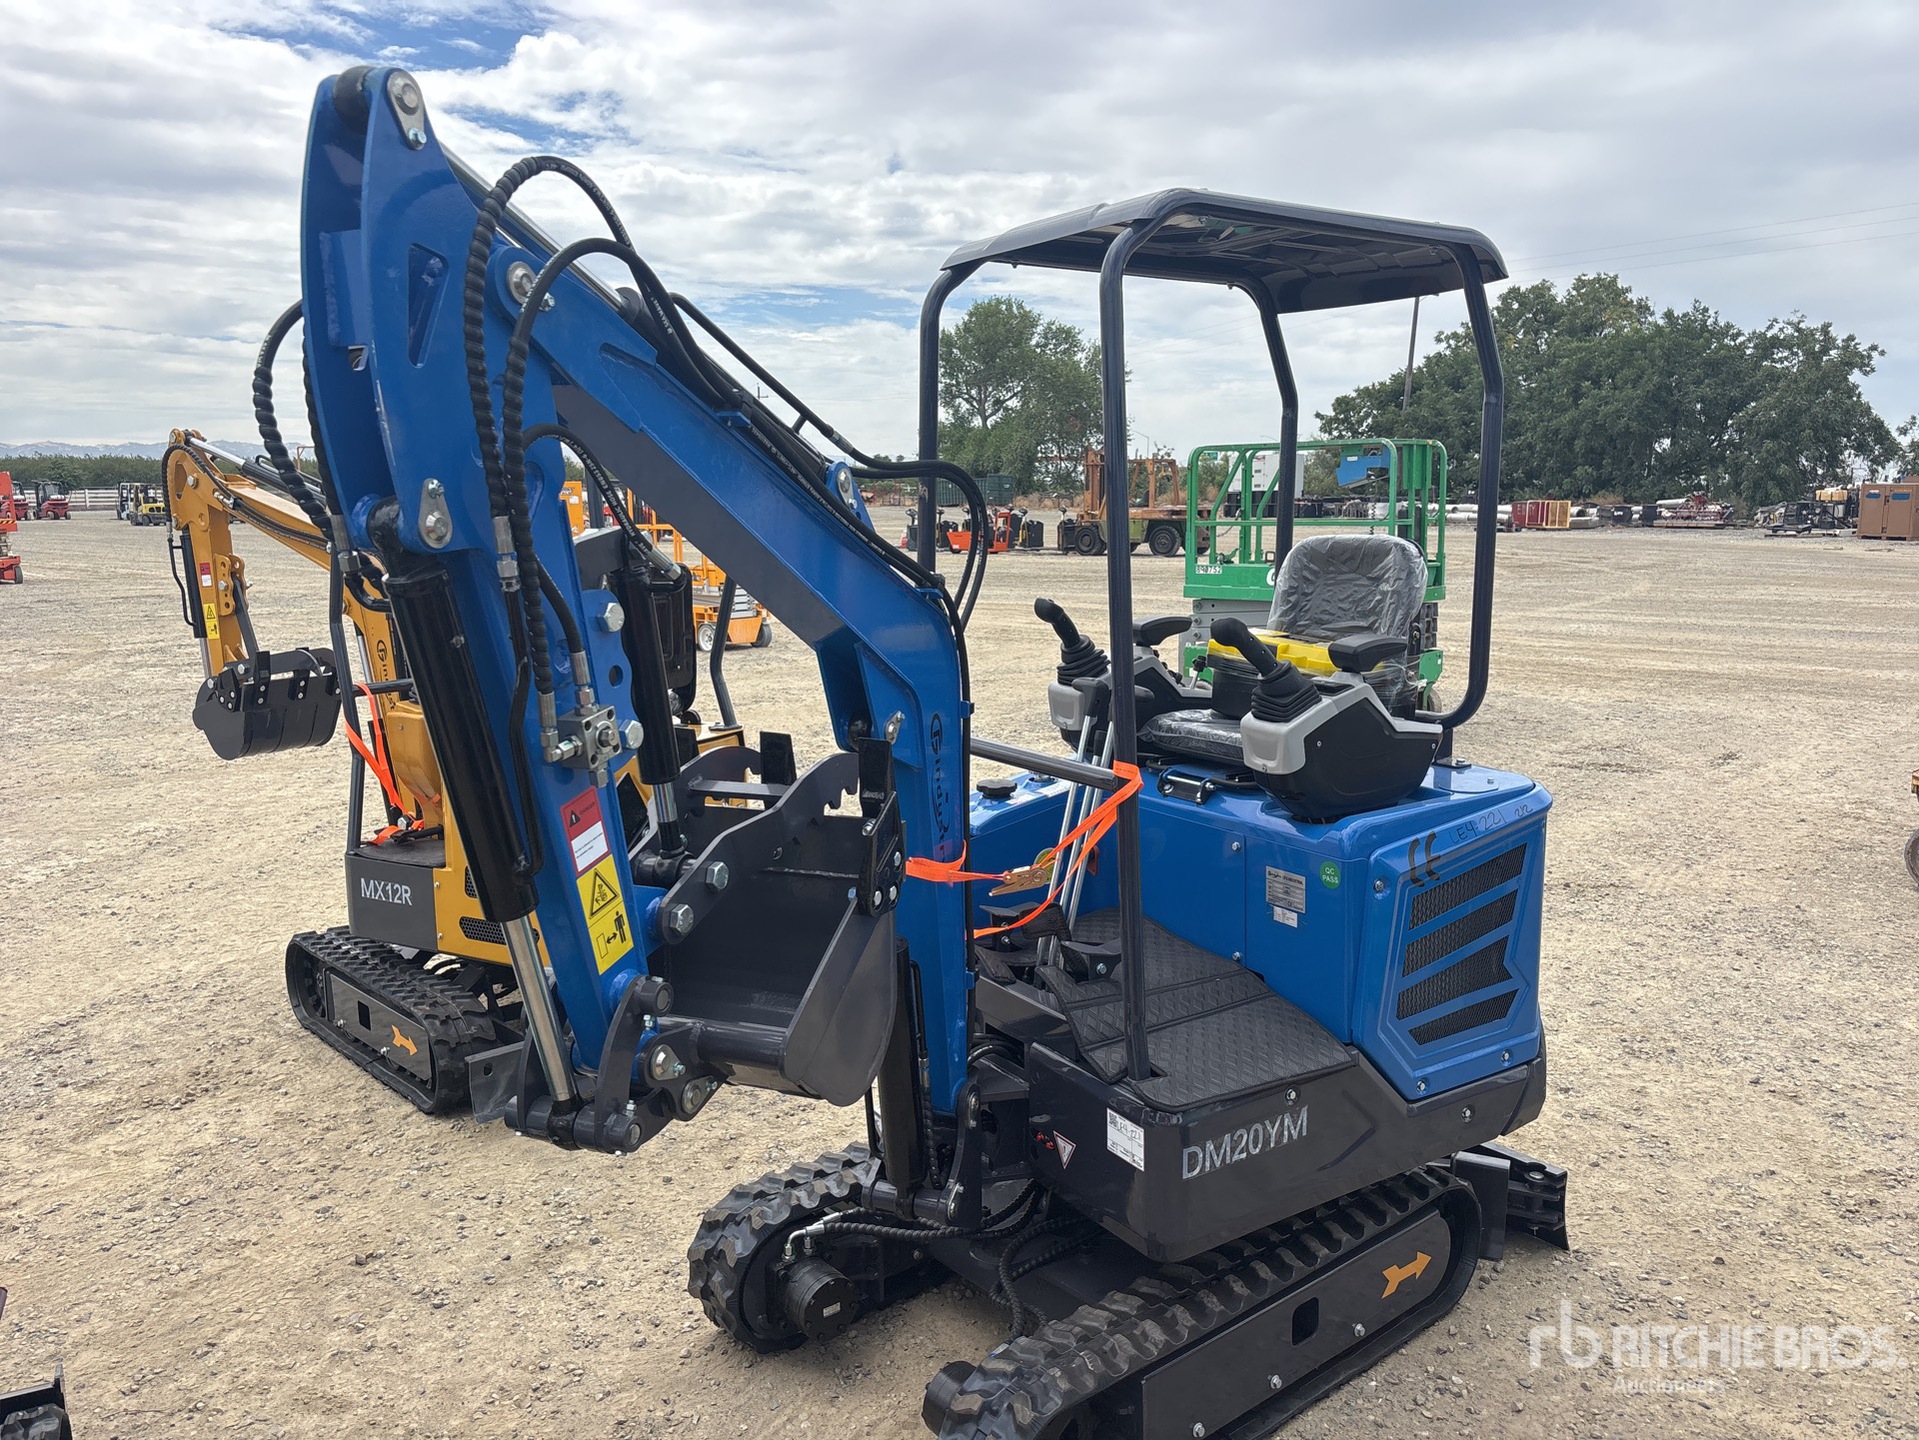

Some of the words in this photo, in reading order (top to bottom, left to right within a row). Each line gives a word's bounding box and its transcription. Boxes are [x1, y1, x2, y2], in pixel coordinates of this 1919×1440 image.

[605, 490, 619, 506] HOSE
[614, 505, 637, 538] HYDRAULIC
[1322, 875, 1339, 884] PASS
[1325, 867, 1335, 875] QC
[361, 878, 413, 906] MX12R
[1182, 1105, 1309, 1180] DM20YM
